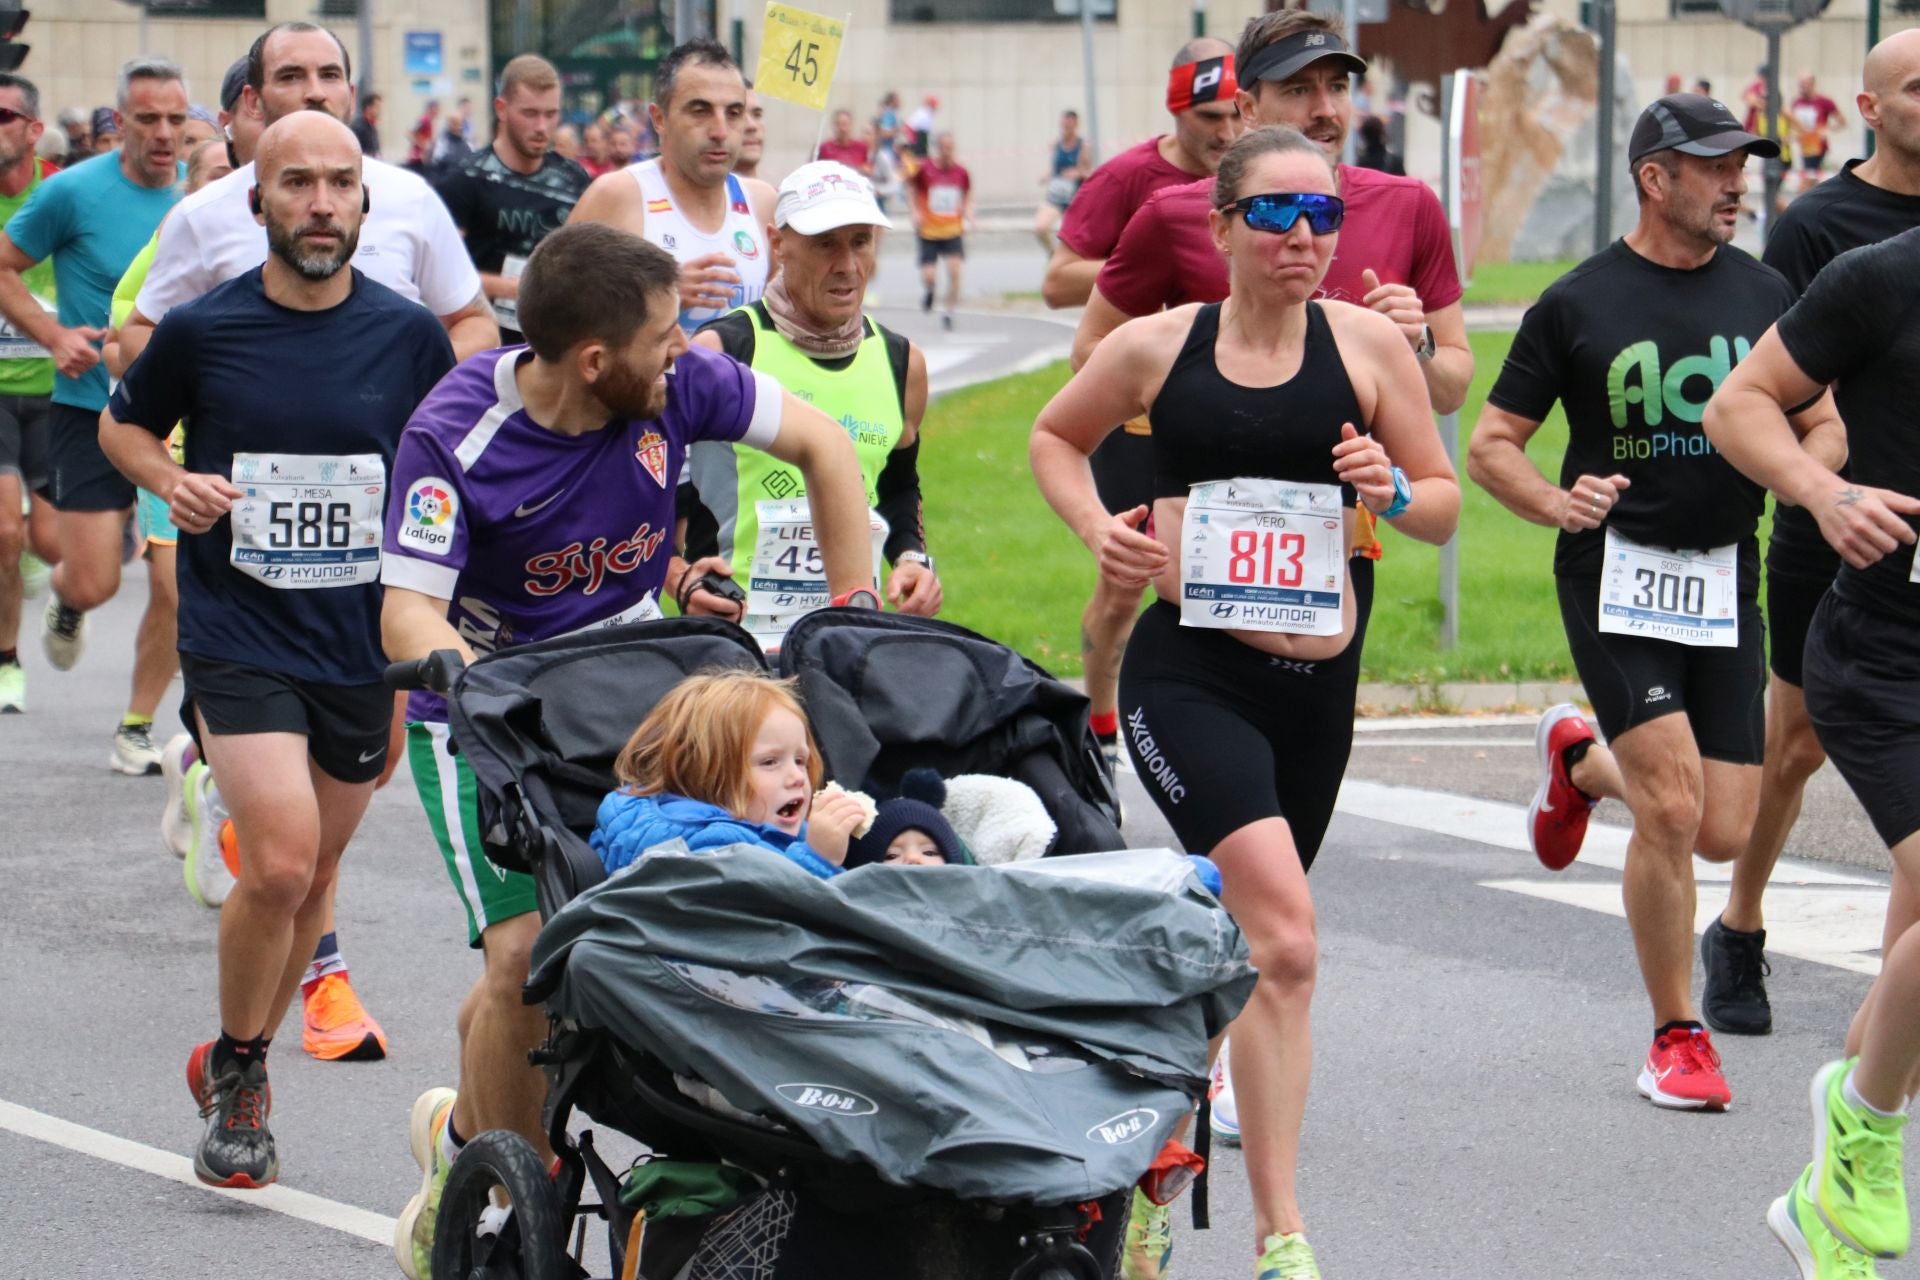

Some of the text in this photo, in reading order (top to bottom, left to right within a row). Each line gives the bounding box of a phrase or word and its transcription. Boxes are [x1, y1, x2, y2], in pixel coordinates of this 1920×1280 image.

[784, 39, 820, 86] 45
[858, 432, 888, 447] NIEVE
[269, 501, 351, 548] 586
[1254, 515, 1287, 529] VERO
[405, 526, 447, 544] LaLiga
[778, 526, 816, 541] LIE
[774, 545, 825, 575] 45
[1228, 530, 1306, 588] 813
[290, 565, 358, 579] HYUNDAI
[1633, 568, 1705, 616] 300
[1243, 605, 1316, 623] HYUNDAI
[1652, 623, 1713, 639] HYUNDAI
